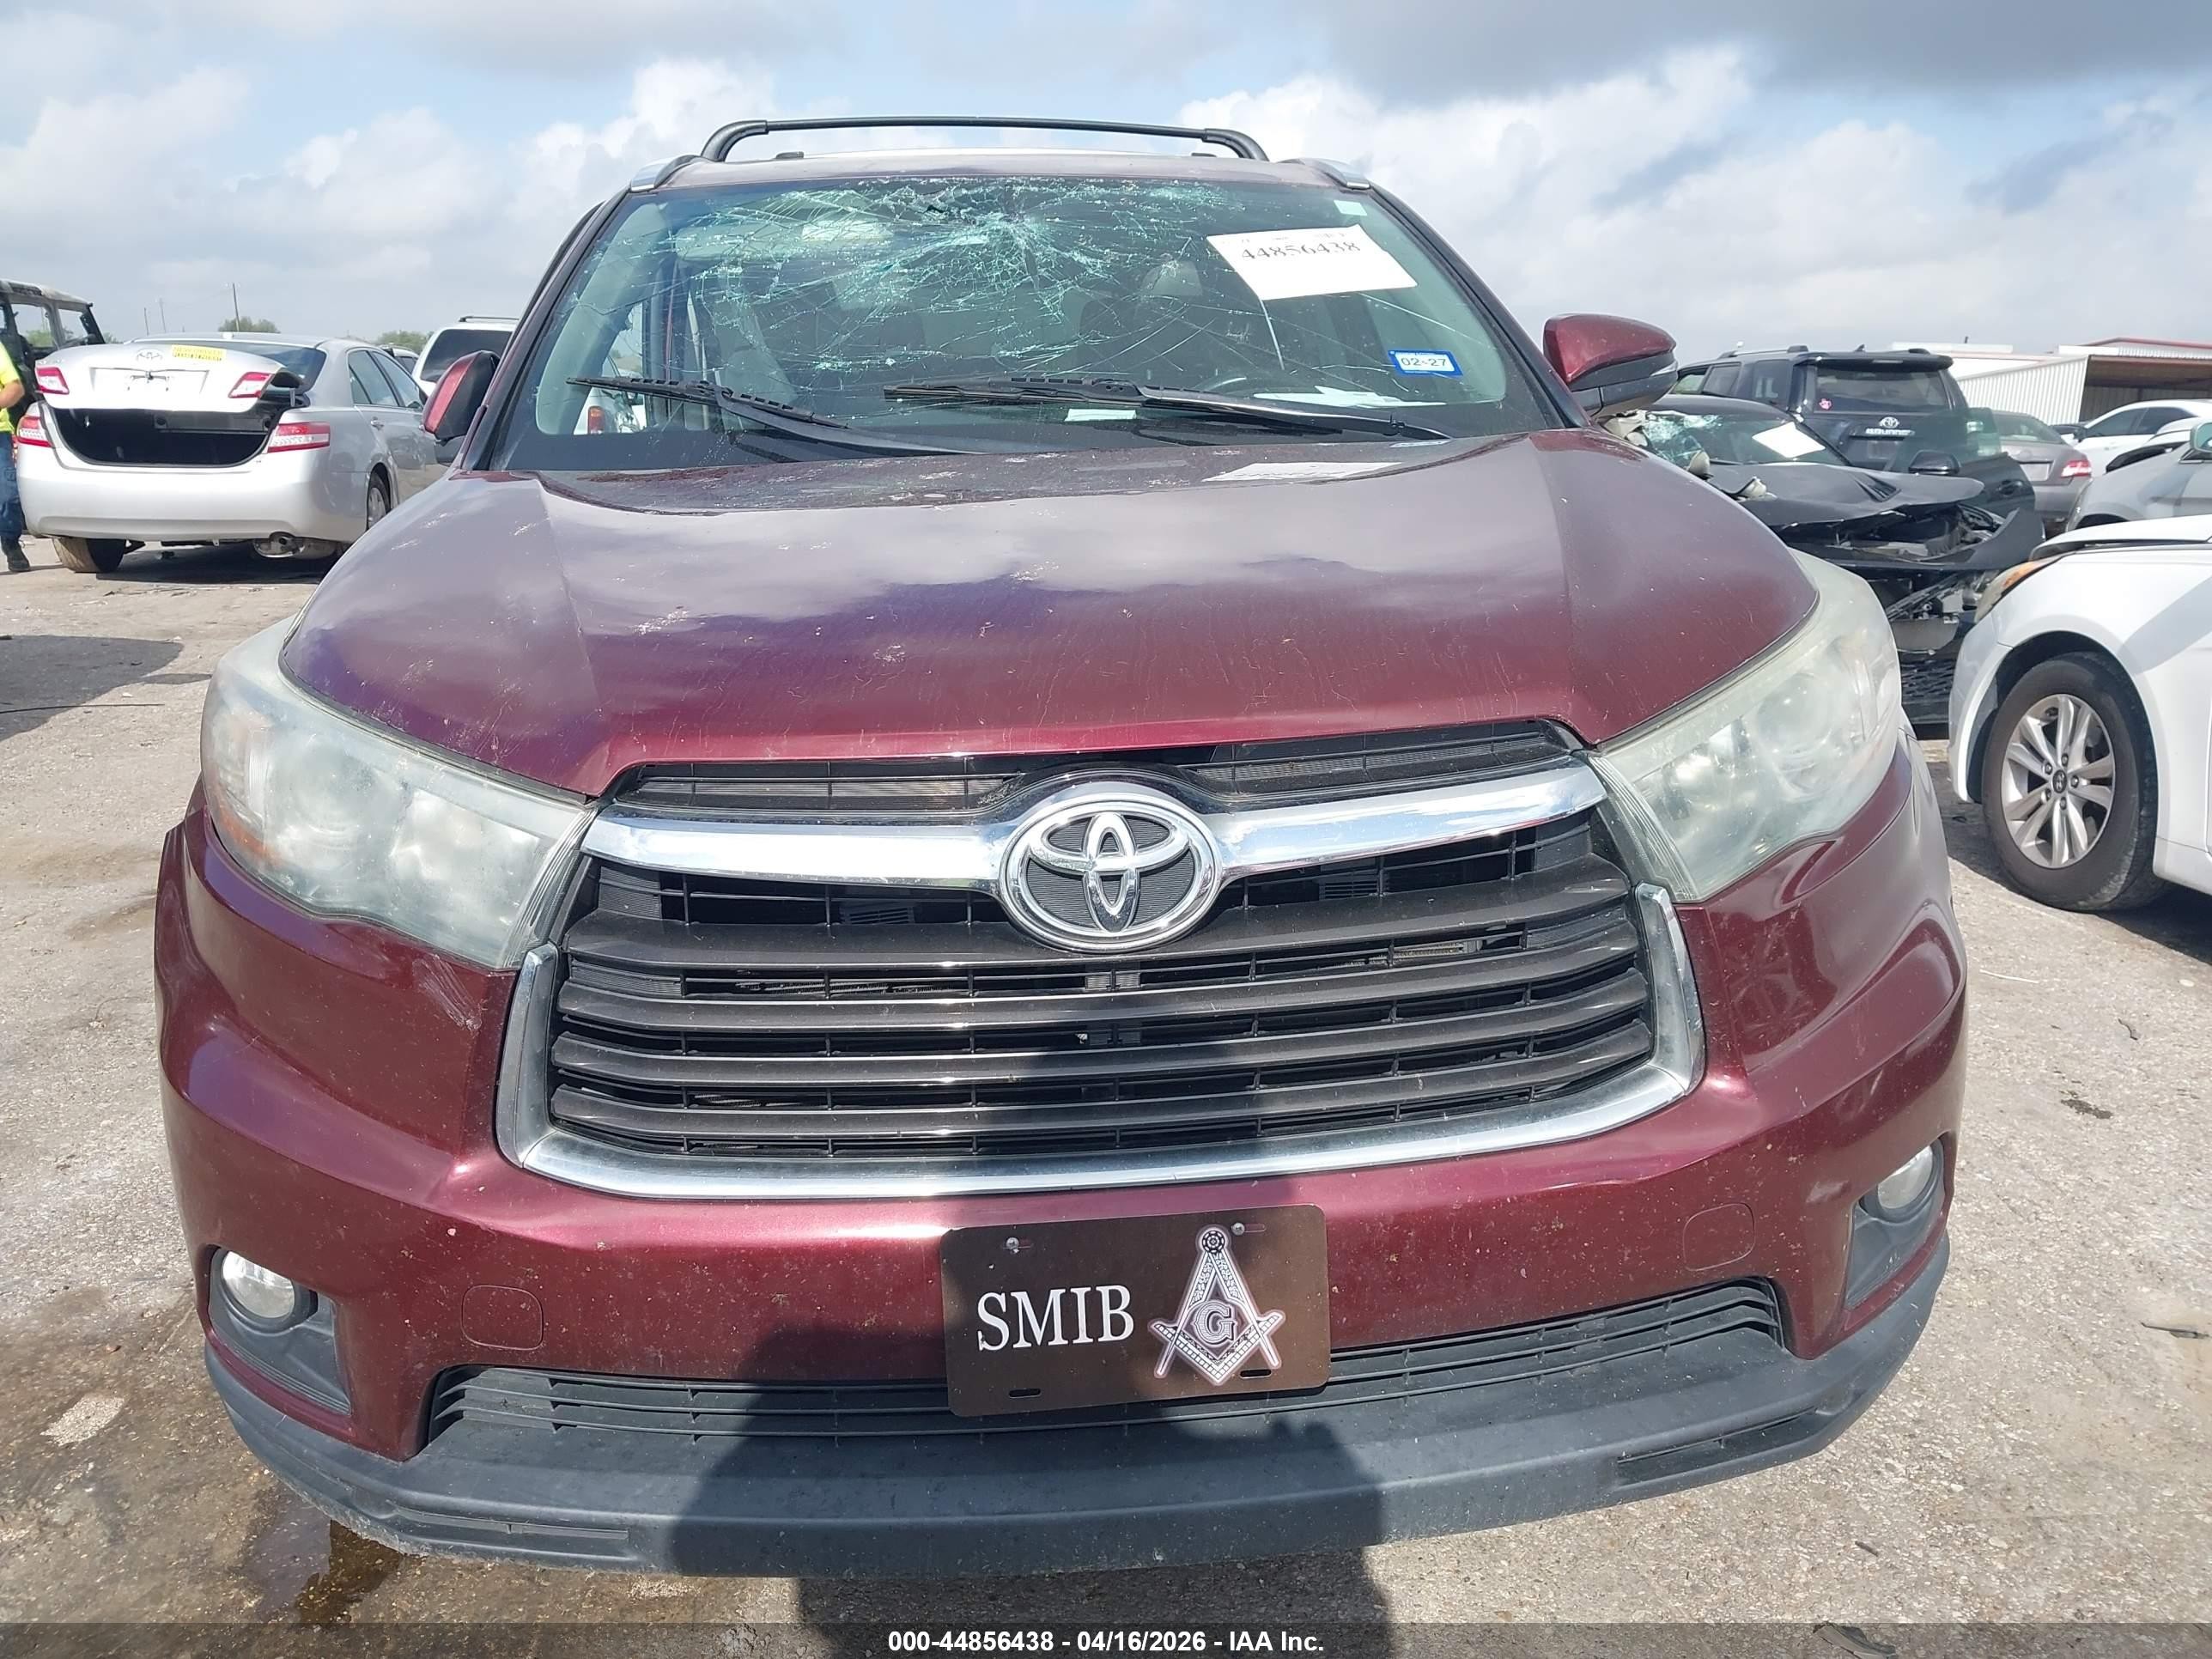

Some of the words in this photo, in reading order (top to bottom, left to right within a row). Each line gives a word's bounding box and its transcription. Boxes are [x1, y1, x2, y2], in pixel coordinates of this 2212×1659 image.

[1242, 241, 1361, 259] 44856438
[1401, 357, 1446, 367] 02-27
[977, 1285, 1134, 1351] SMIB
[1195, 1302, 1236, 1346] G
